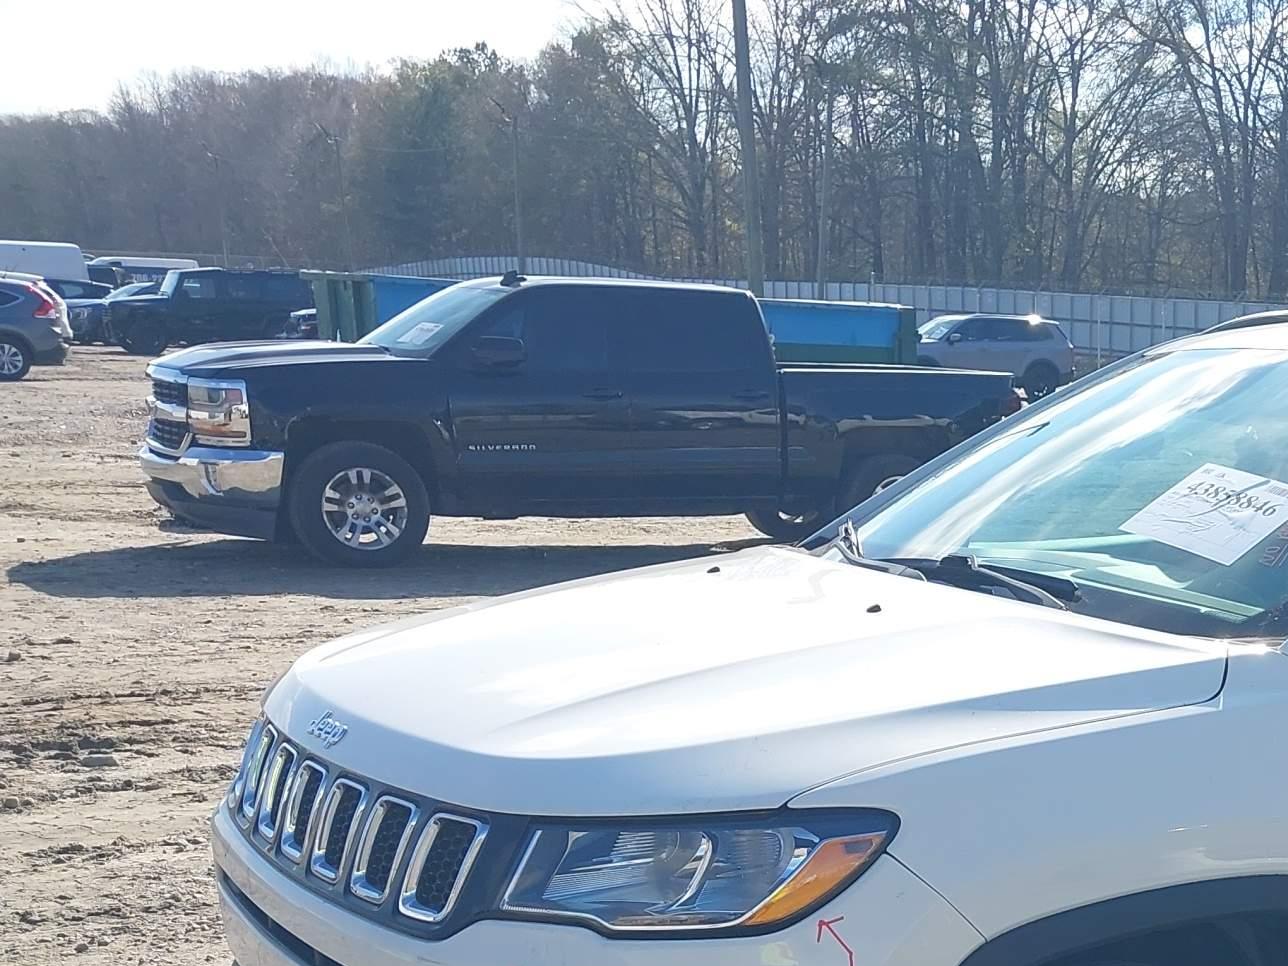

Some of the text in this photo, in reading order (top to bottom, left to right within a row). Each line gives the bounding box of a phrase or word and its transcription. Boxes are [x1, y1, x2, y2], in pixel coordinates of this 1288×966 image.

[468, 444, 537, 452] SILVERADO
[1187, 481, 1284, 517] 43858846
[307, 710, 348, 749] Jeep
